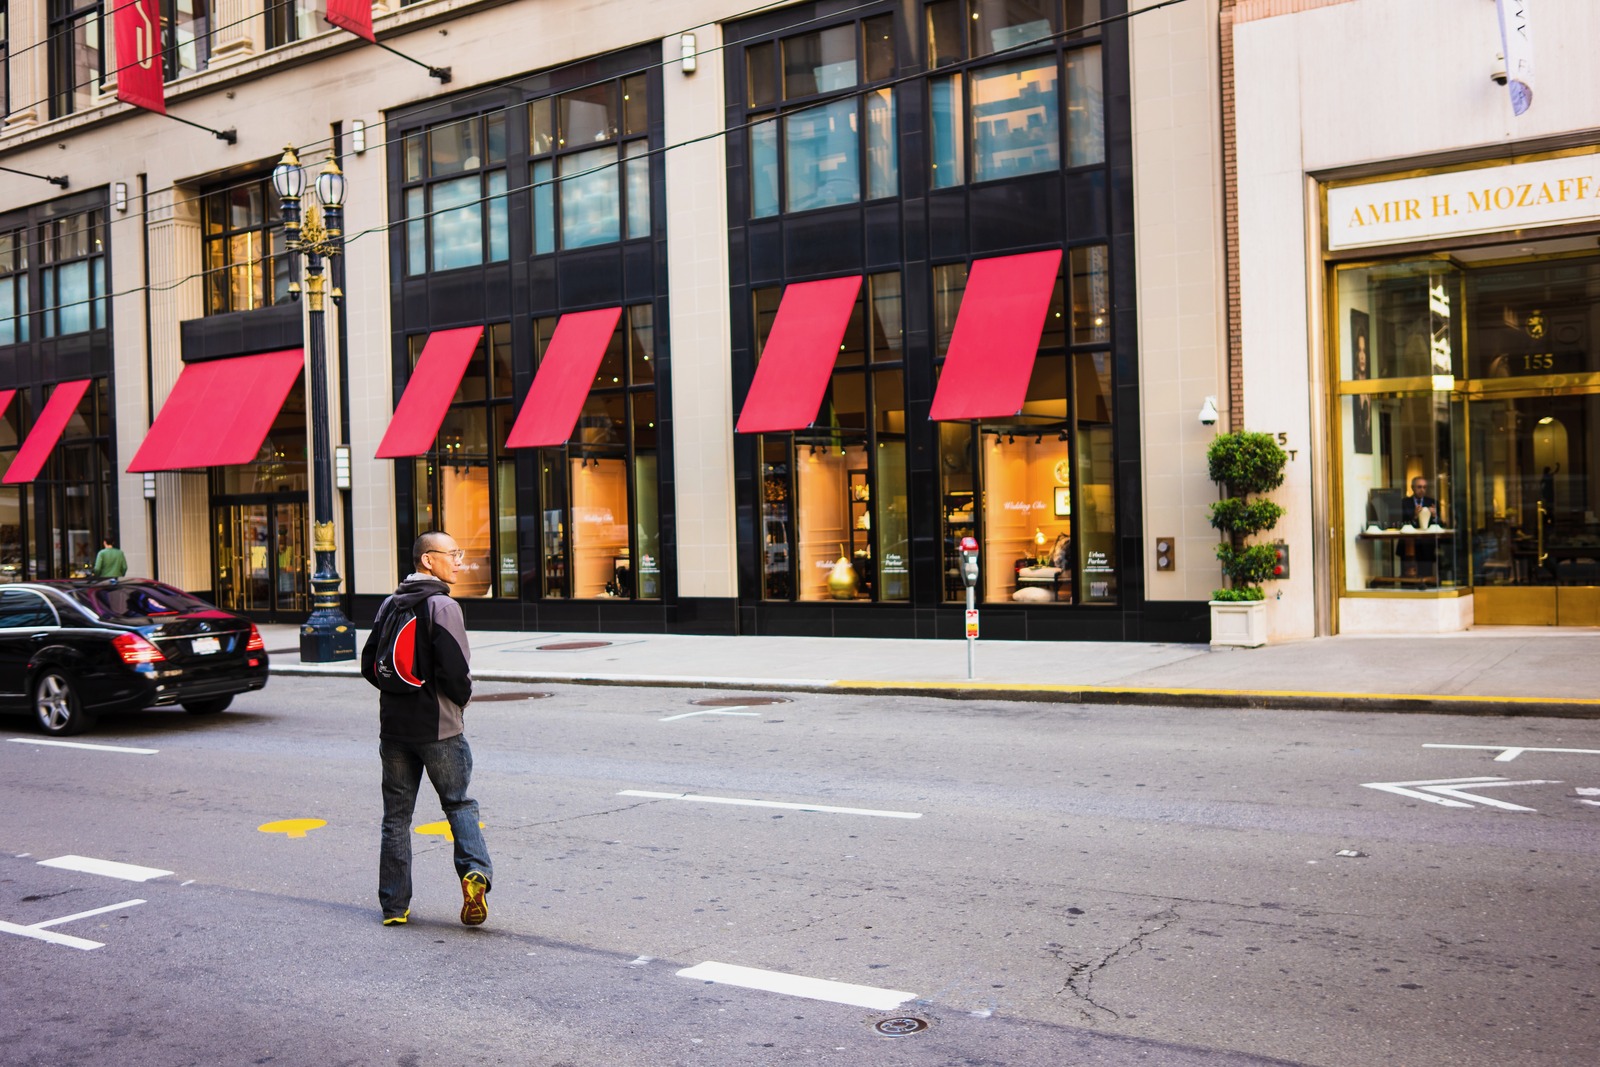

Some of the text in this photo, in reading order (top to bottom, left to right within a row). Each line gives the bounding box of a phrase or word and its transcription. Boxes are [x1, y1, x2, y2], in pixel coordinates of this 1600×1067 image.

[1348, 199, 1421, 228] AMIR
[1432, 194, 1458, 217] H.
[1523, 353, 1554, 370] 155
